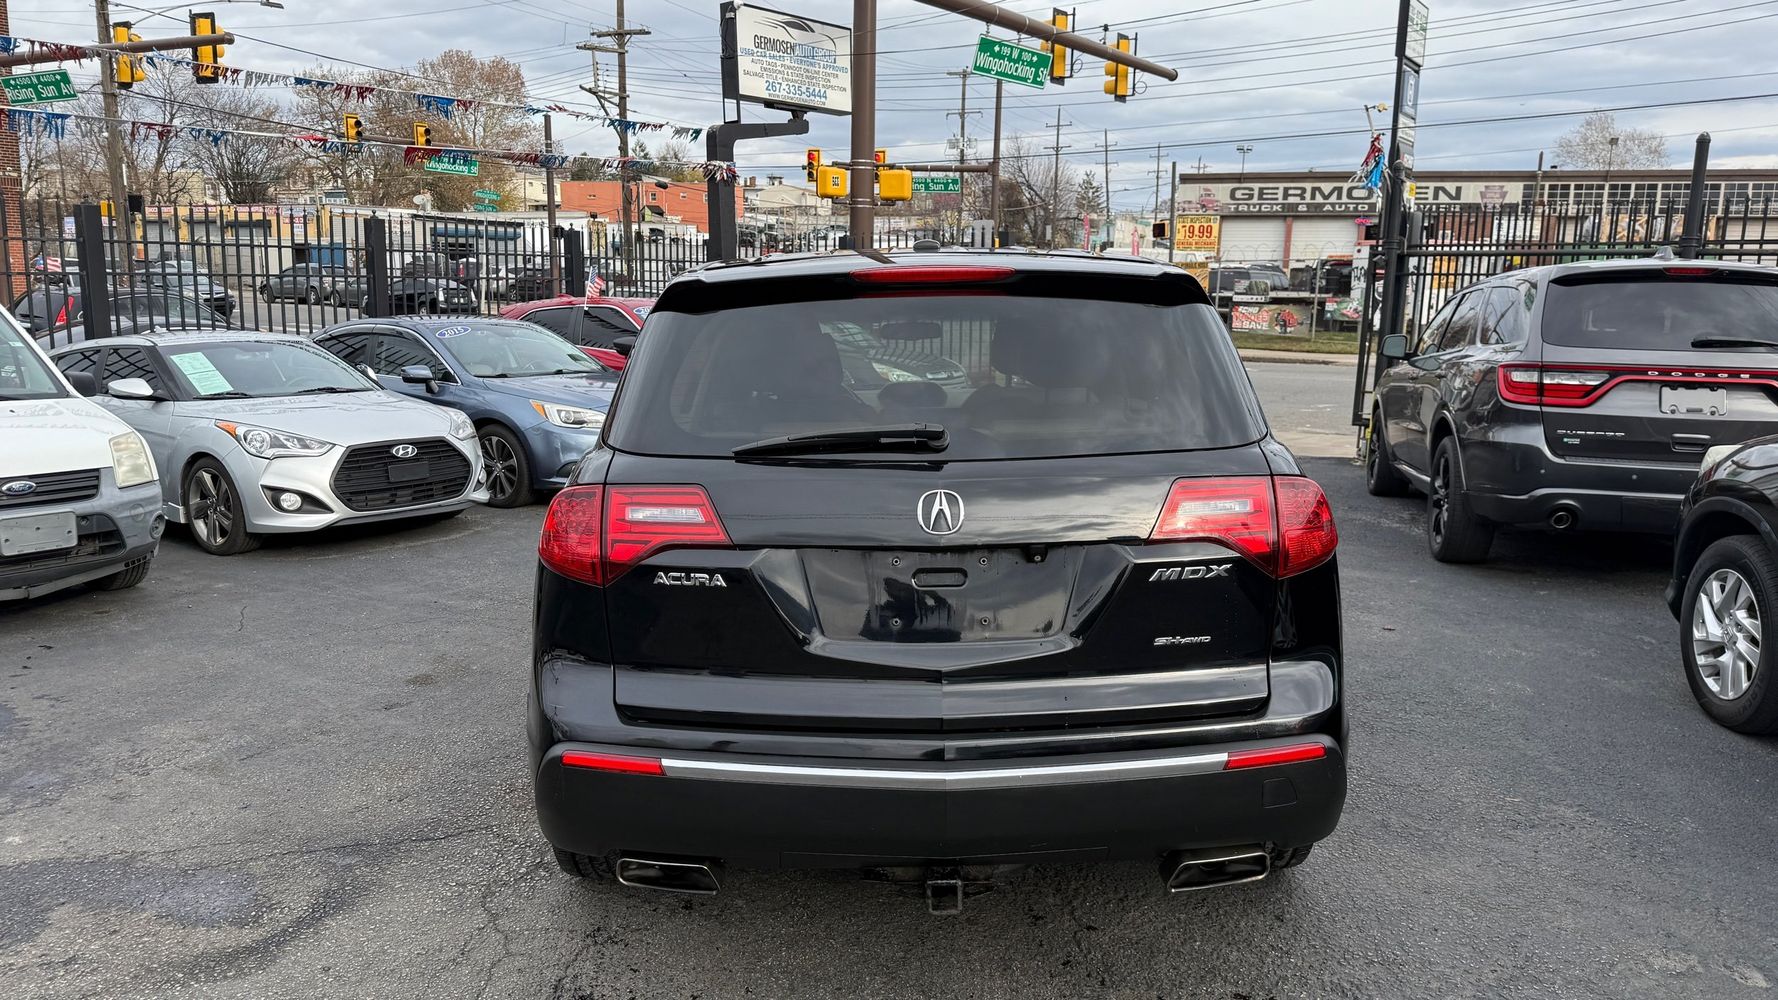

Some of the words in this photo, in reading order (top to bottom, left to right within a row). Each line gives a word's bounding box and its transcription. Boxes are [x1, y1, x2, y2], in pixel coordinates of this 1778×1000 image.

[753, 34, 795, 56] GERMOSEN
[1000, 46, 1011, 56] 199
[1011, 47, 1020, 60] W
[1021, 51, 1032, 62] 100
[740, 47, 755, 56] USED
[756, 50, 768, 59] CAR
[769, 52, 785, 62] SALES
[789, 56, 821, 70] EVERYONE'S
[822, 62, 848, 74] APPROVED
[751, 58, 764, 66] AUTO
[766, 60, 778, 68] TAGS
[821, 70, 839, 79] CENTER
[976, 52, 1035, 83] Wingohocking
[1037, 67, 1047, 83] St
[16, 76, 31, 85] 4500
[30, 75, 38, 85] N
[40, 74, 55, 82] 4400
[743, 69, 764, 79] SALVAGE
[782, 77, 806, 86] ENHANCED
[822, 83, 847, 92] INSPECTION
[760, 66, 785, 76] EMISSIONS
[805, 74, 831, 84] INSPECTION
[5, 86, 37, 102] Rising
[37, 84, 58, 98] Sun
[60, 82, 74, 95] Av
[765, 80, 827, 100] 267-335-5444
[912, 182, 924, 192] ing
[928, 182, 944, 191] Sun
[947, 183, 959, 191] Av
[1229, 186, 1462, 201] GERMOEN
[1228, 204, 1283, 212] TRUCK
[1297, 204, 1308, 212] &
[1322, 204, 1369, 212] AUTO
[443, 326, 465, 337] 2015
[653, 571, 727, 588] ACURA
[1148, 563, 1233, 582] MDX
